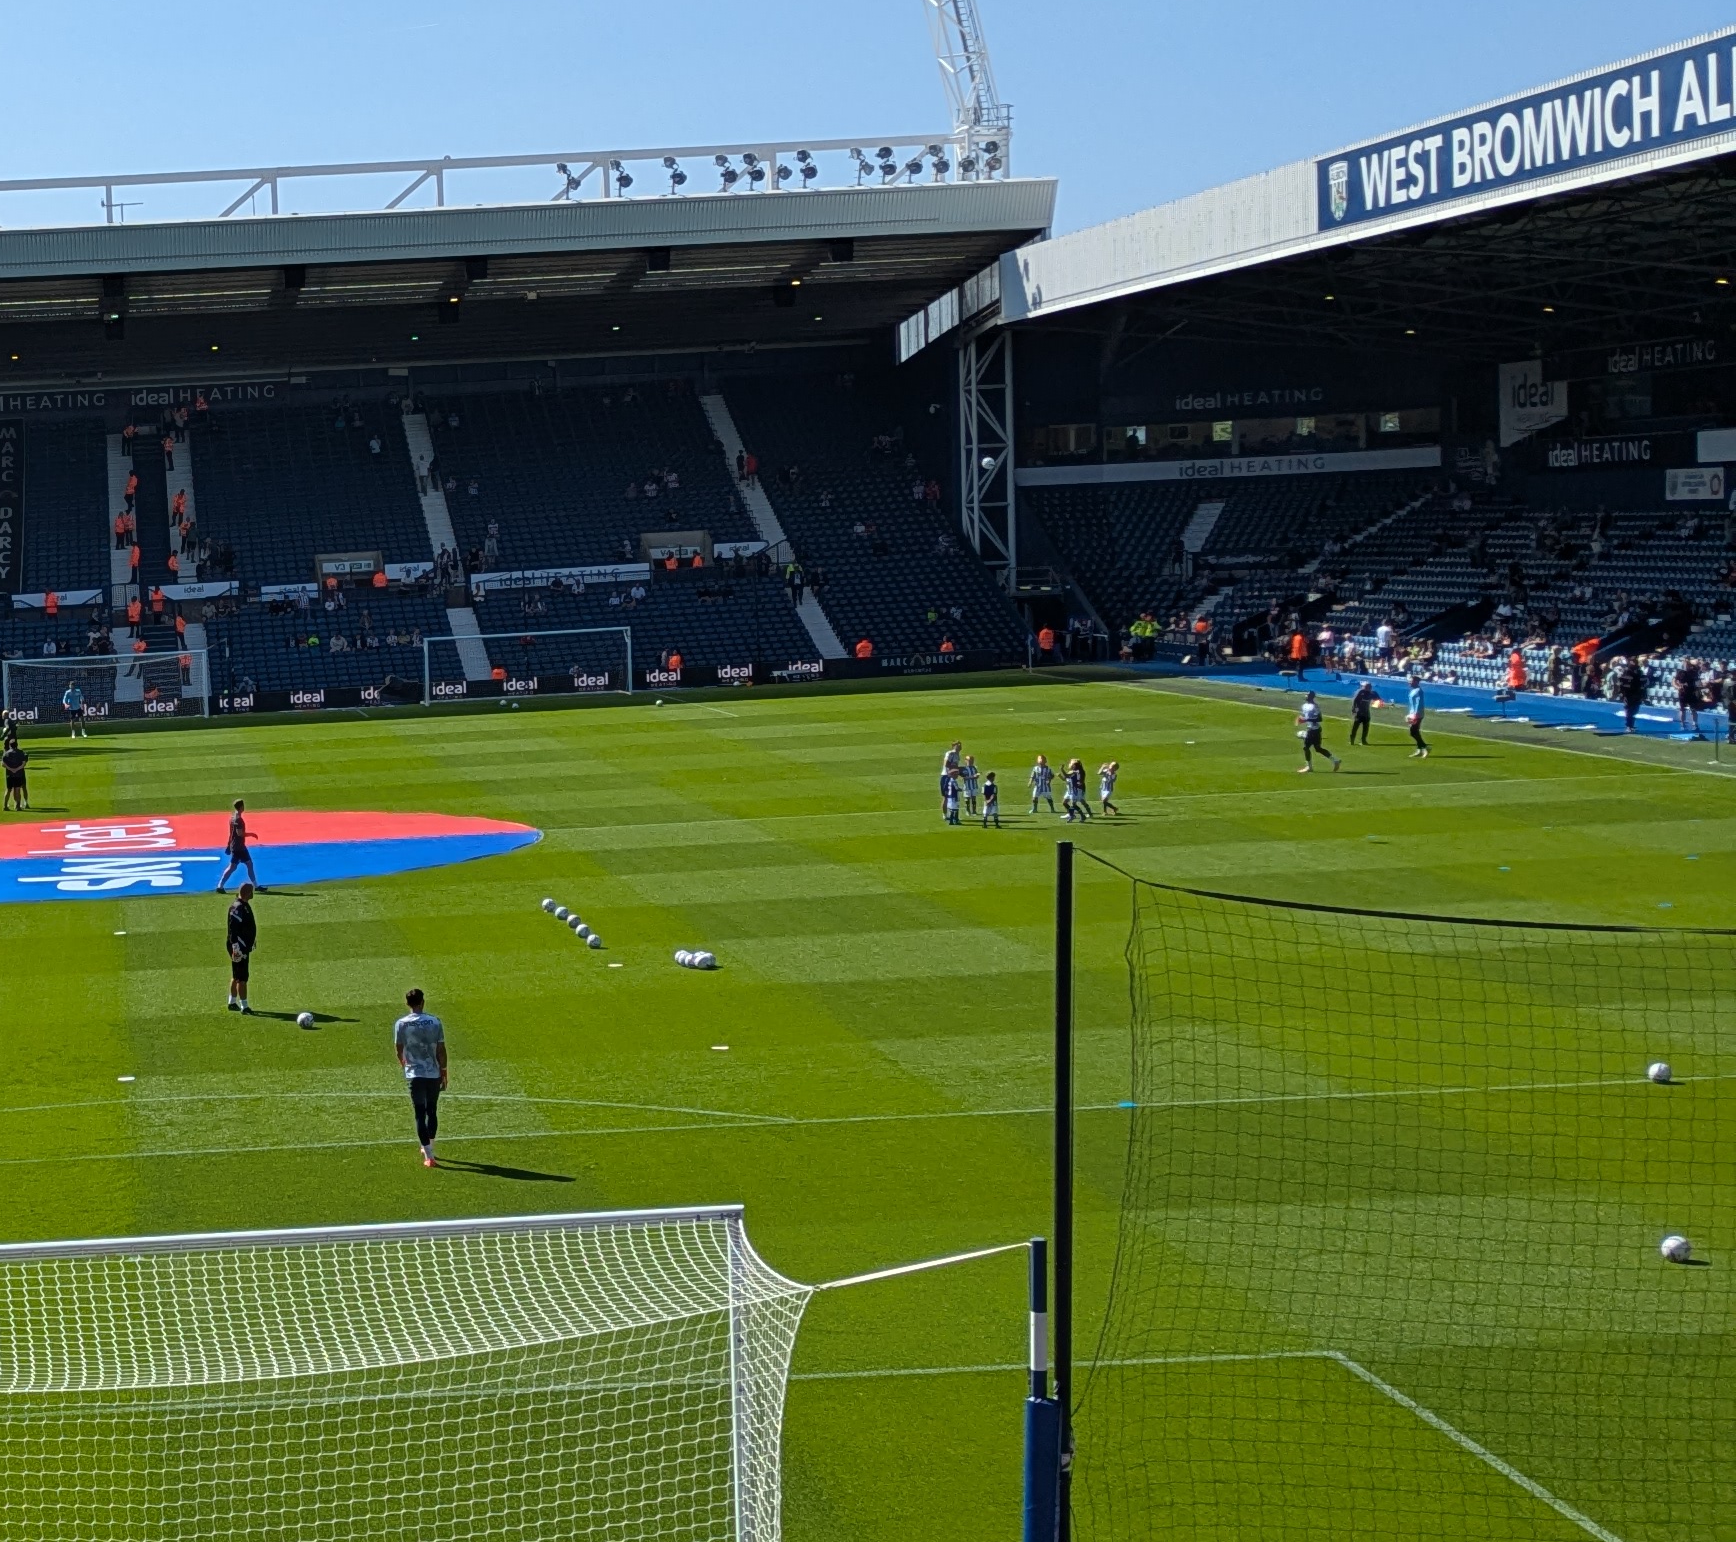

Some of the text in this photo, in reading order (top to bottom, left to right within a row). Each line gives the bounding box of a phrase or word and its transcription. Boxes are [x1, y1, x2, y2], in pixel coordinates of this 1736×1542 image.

[1360, 134, 1443, 211] WEST
[1451, 70, 1661, 189] BROMWICH
[1642, 339, 1716, 365] HEATING
[132, 388, 174, 407] ideal
[1175, 387, 1323, 411] ideal HEATING
[1512, 373, 1555, 408] ideal
[9, 394, 105, 411] HEATING
[0, 427, 17, 482] MARC
[1548, 440, 1651, 467] ideal HEATING
[1179, 457, 1325, 477] ideal HEATING
[574, 672, 609, 687] ideal
[645, 668, 681, 683] ideal
[717, 664, 753, 678] ideal
[290, 689, 325, 704] ideal
[432, 680, 467, 696] ideal
[27, 819, 177, 855] bet
